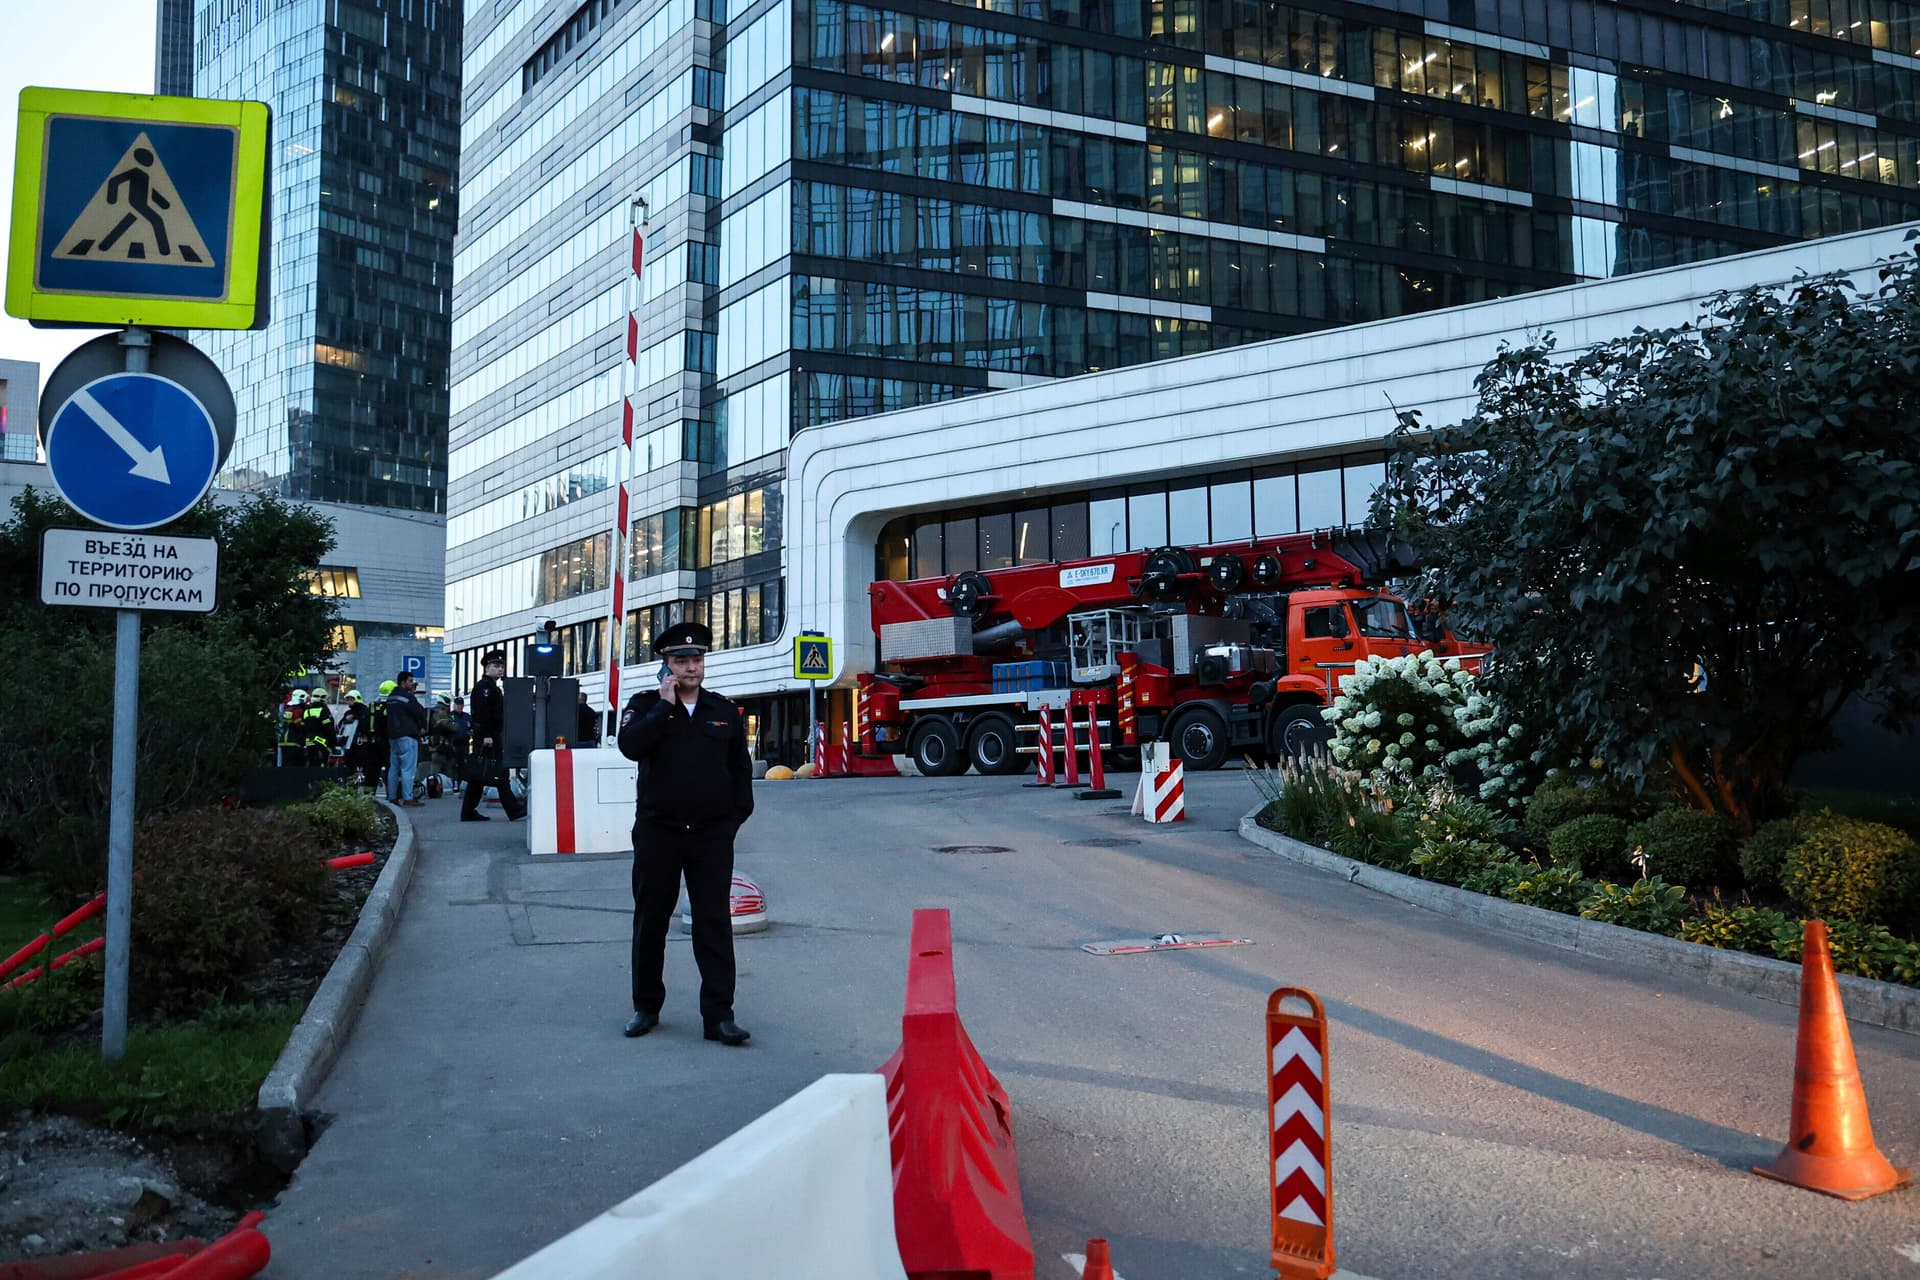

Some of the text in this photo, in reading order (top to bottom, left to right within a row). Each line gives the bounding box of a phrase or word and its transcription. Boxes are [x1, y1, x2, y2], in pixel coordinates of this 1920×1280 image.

[85, 539, 178, 559] ВЪЕЗД НА
[68, 560, 193, 581] ТЕРРИТОРИЮ
[55, 582, 203, 603] ПО ПРОПУСКАМ
[407, 657, 421, 672] P
